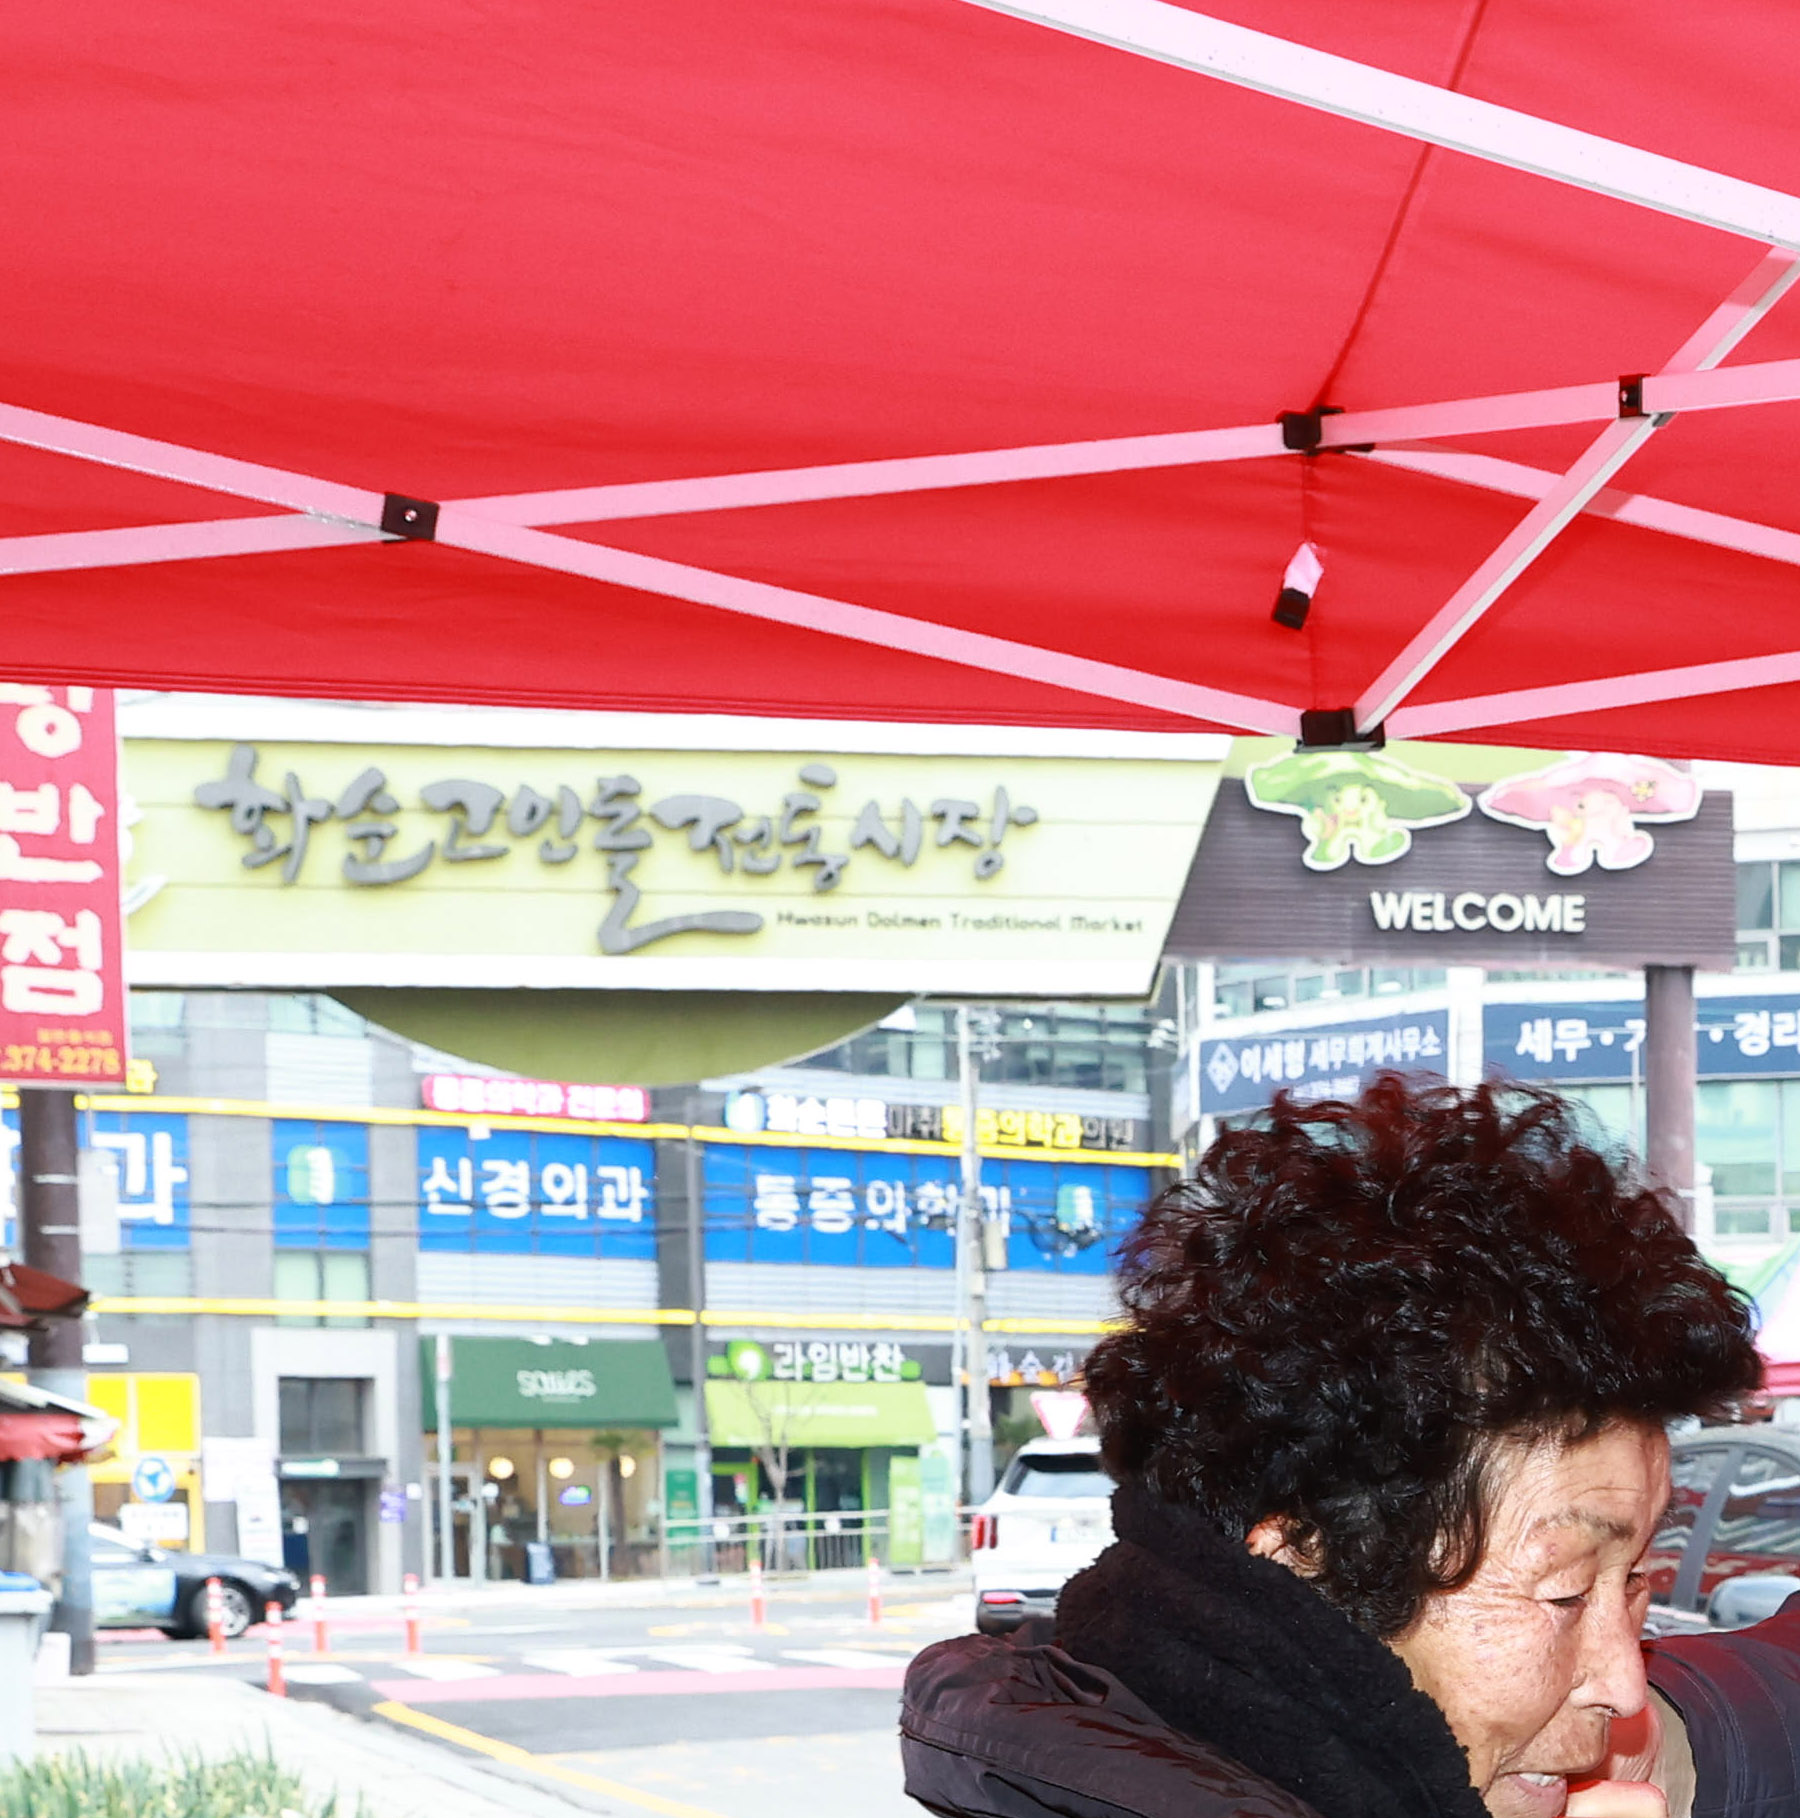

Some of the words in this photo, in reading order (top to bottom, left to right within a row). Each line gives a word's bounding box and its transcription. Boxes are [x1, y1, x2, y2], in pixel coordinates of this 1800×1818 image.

[950, 913, 1061, 932] Traditional
[1070, 915, 1144, 933] Market
[1371, 891, 1586, 933] WELCOME
[1515, 1017, 1592, 1062] 세무
[422, 1156, 650, 1223] 신경외과
